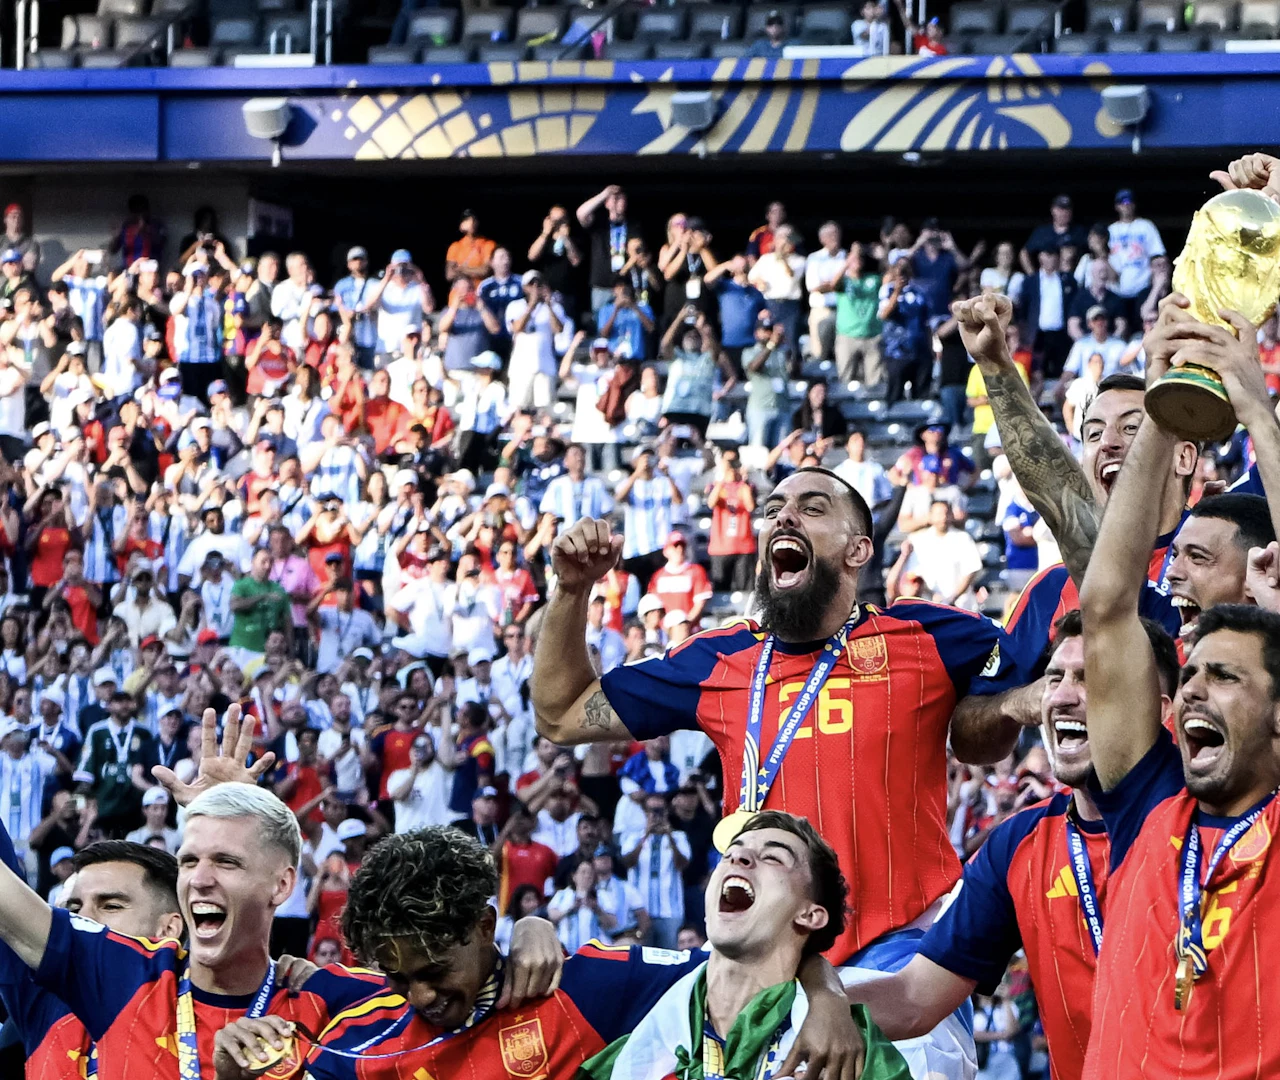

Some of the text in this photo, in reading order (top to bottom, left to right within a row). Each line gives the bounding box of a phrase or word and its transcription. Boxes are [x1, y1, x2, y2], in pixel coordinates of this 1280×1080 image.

[770, 662, 829, 765] FIFA WORLD CUP 2026
[778, 677, 854, 741] 26
[1222, 819, 1250, 847] WORLD
[1185, 851, 1197, 868] CUP
[1071, 833, 1103, 951] FIFA WORLD CUP 202
[1182, 868, 1196, 905] WORLD
[250, 985, 271, 1018] WORLD
